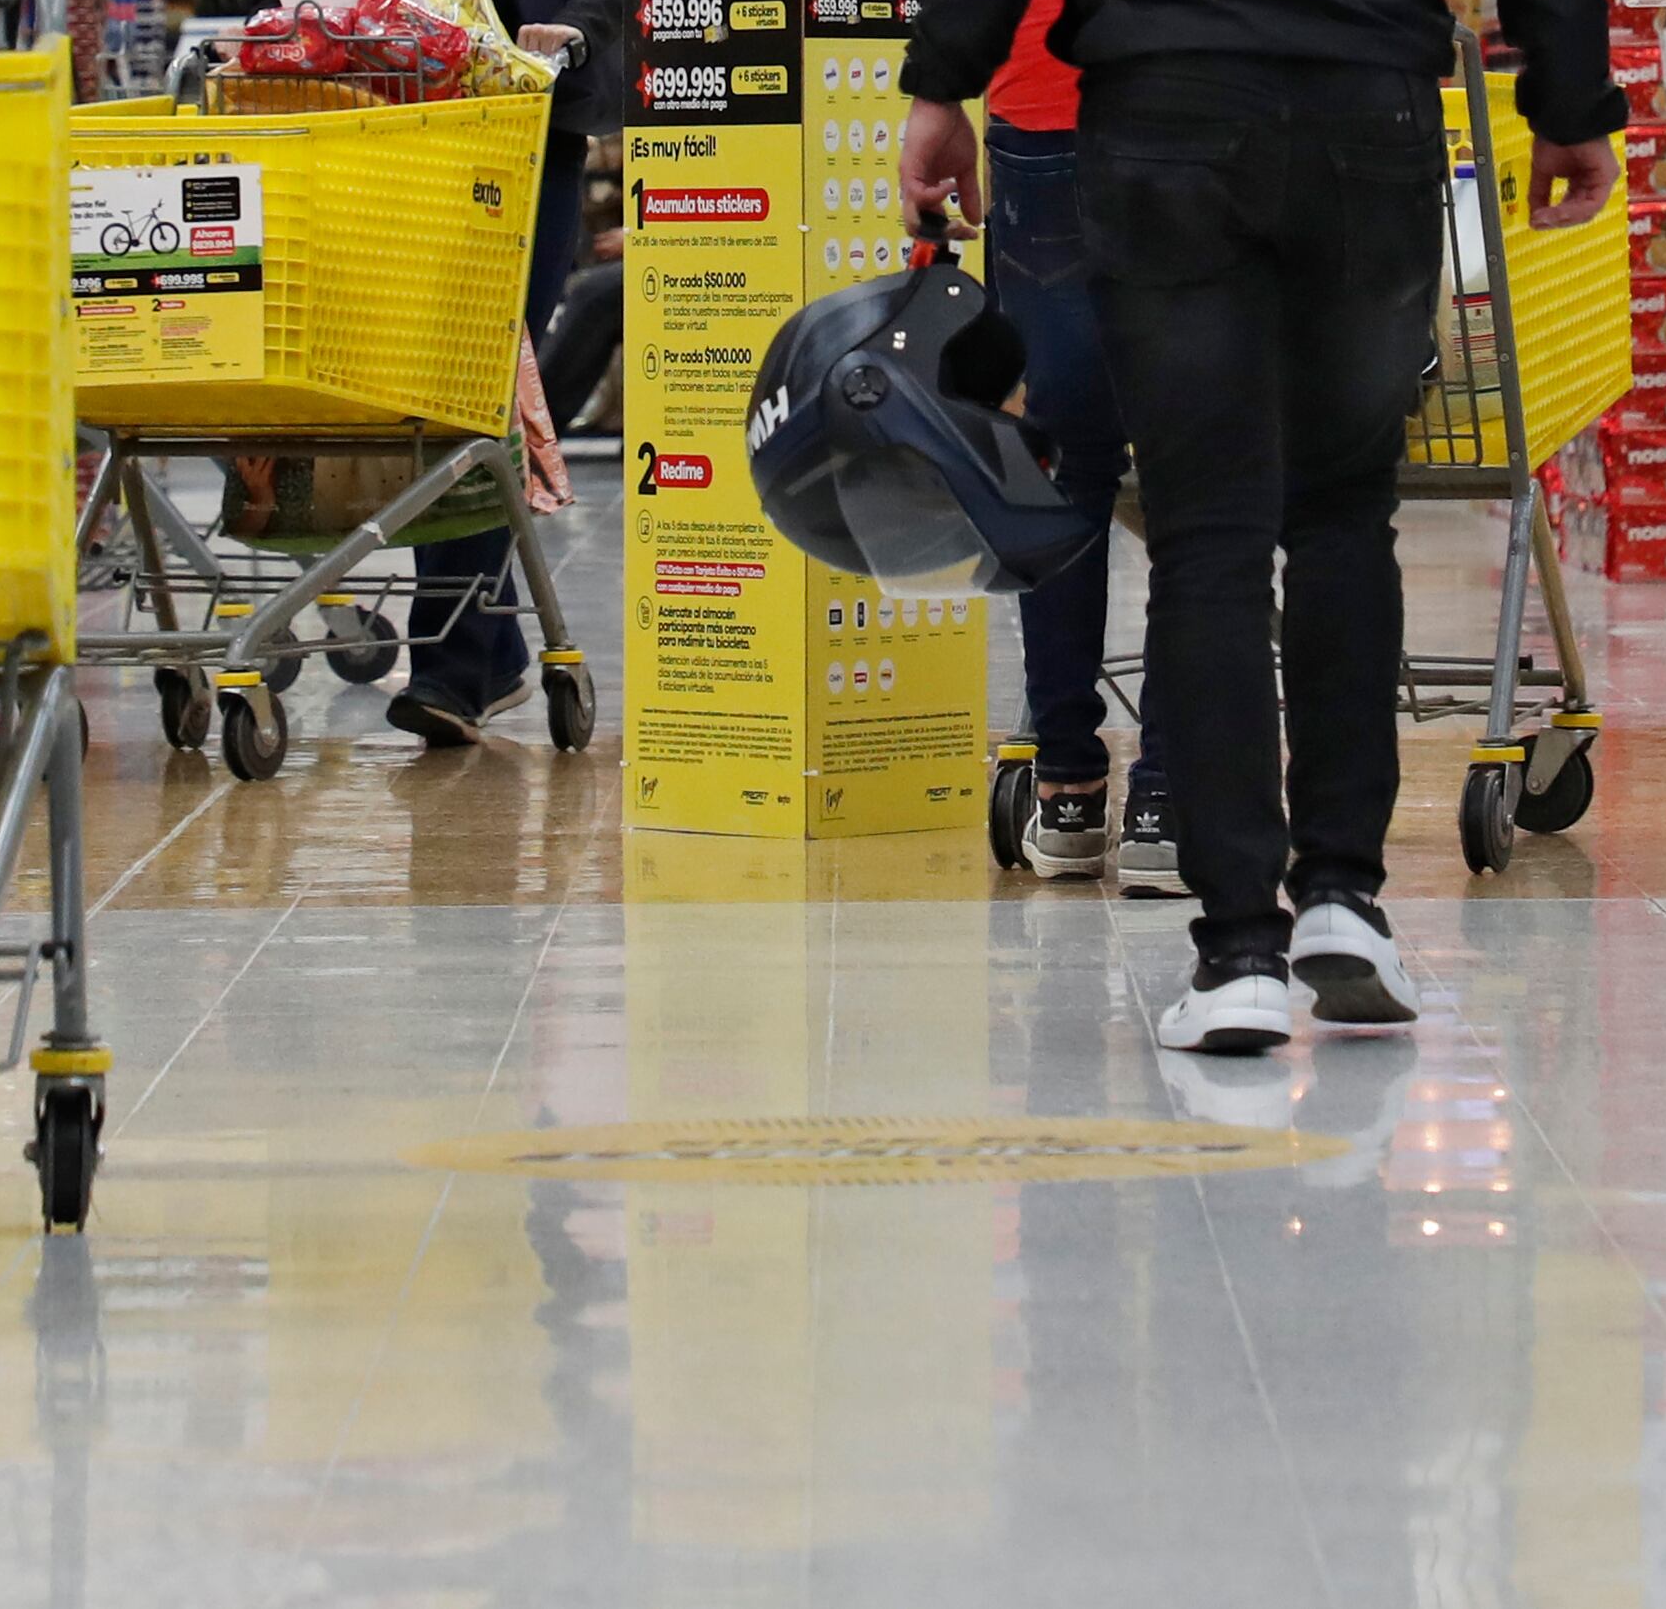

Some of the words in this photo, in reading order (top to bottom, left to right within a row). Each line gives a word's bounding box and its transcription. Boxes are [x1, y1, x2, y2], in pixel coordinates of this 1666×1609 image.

[748, 4, 778, 18] stickers
[645, 66, 726, 98] $699.995
[751, 69, 781, 82] stickers
[631, 137, 650, 162] ¡Es
[652, 141, 681, 161] muy
[684, 135, 717, 157] fácil!
[472, 177, 502, 210] éxito
[631, 178, 644, 230] 1
[645, 194, 696, 213] Acumula
[697, 196, 715, 213] tus
[716, 193, 762, 213] stickers
[663, 274, 679, 288] Por
[680, 274, 703, 288] cada
[704, 271, 746, 290] $50.000
[663, 349, 679, 363] Por
[680, 349, 703, 363] cada
[704, 346, 752, 366] $100.000
[637, 441, 658, 495] 2
[660, 460, 705, 481] Redime
